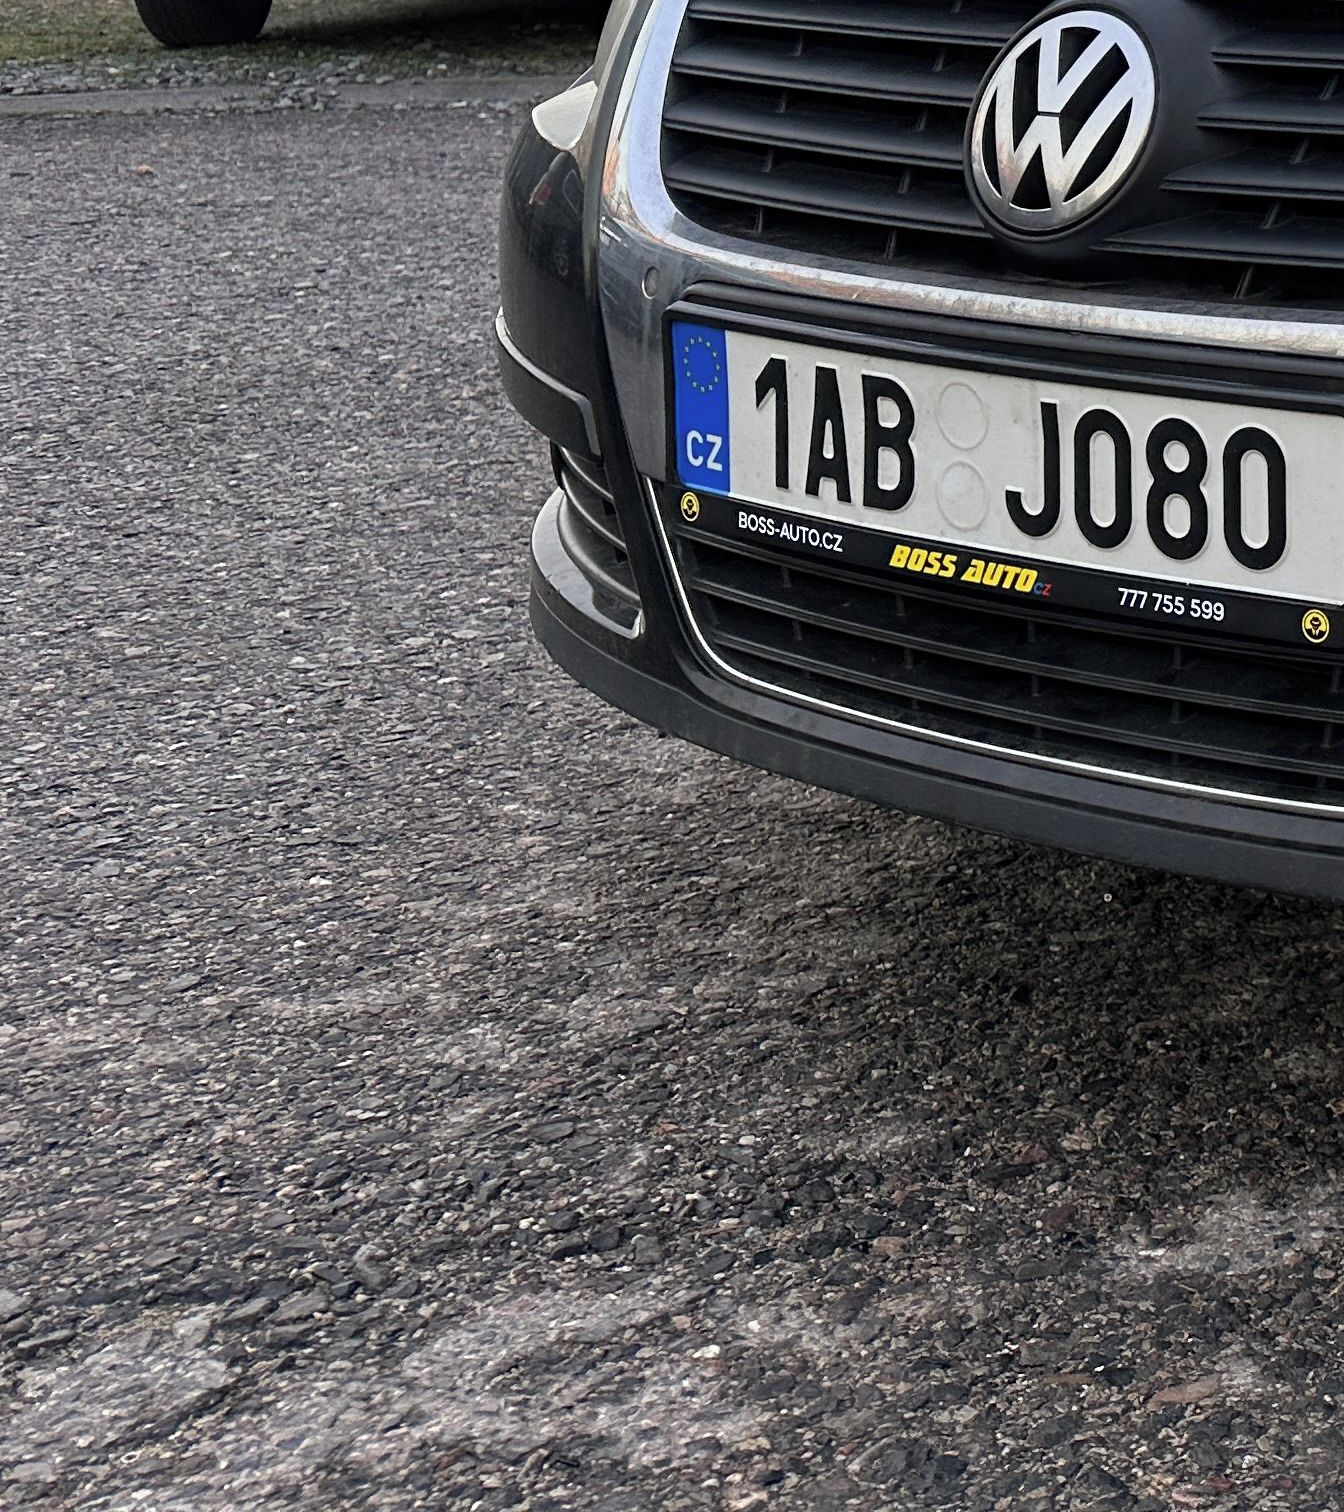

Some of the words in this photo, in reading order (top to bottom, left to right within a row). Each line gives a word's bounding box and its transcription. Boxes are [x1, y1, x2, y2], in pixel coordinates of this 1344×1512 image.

[686, 429, 723, 472] CZ
[754, 354, 916, 512] 1AB
[1003, 399, 1288, 572] J080
[738, 511, 843, 553] BOSS-AUTO.CZ
[888, 544, 958, 578] BOSS
[960, 558, 1038, 593] AUTO
[1118, 587, 1148, 609] 777
[1152, 592, 1184, 616] 755
[1189, 598, 1224, 621] 599
